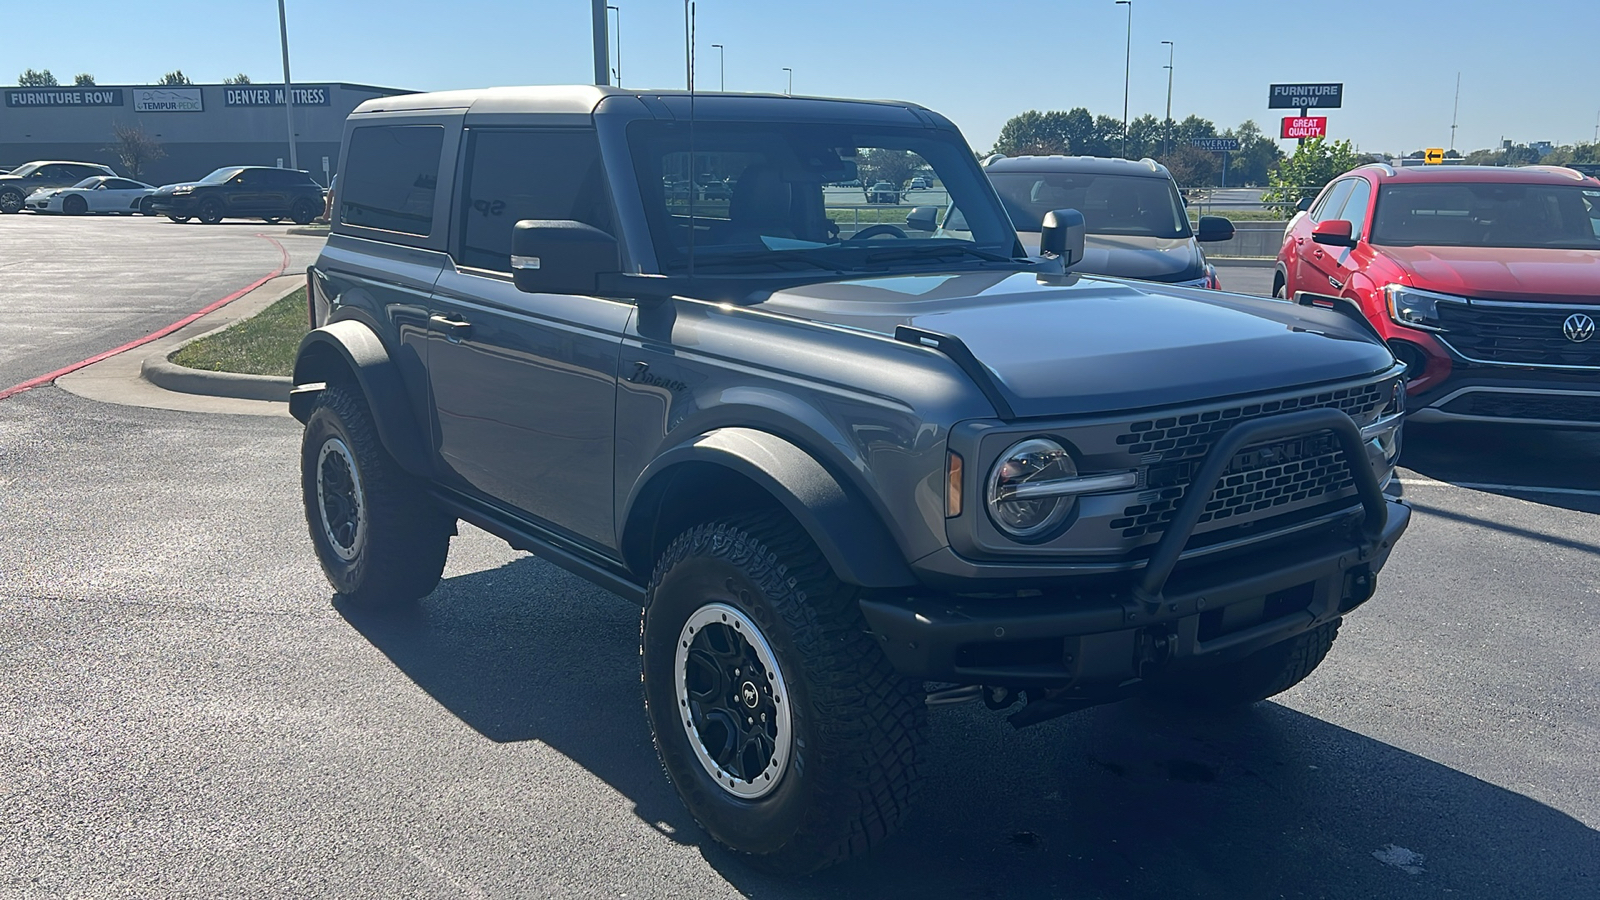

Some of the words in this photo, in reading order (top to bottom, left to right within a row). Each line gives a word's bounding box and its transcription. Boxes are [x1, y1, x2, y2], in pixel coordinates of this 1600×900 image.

[227, 89, 271, 104] DENVER
[274, 88, 325, 104] MTTRESS
[1274, 86, 1338, 96] FURNITURE
[11, 92, 81, 105] FURNITURE
[84, 91, 114, 104] ROW
[1291, 96, 1319, 106] ROW
[1292, 118, 1318, 128] GREAT
[1288, 127, 1321, 137] QUALITY
[1194, 139, 1237, 147] HAVERTYS
